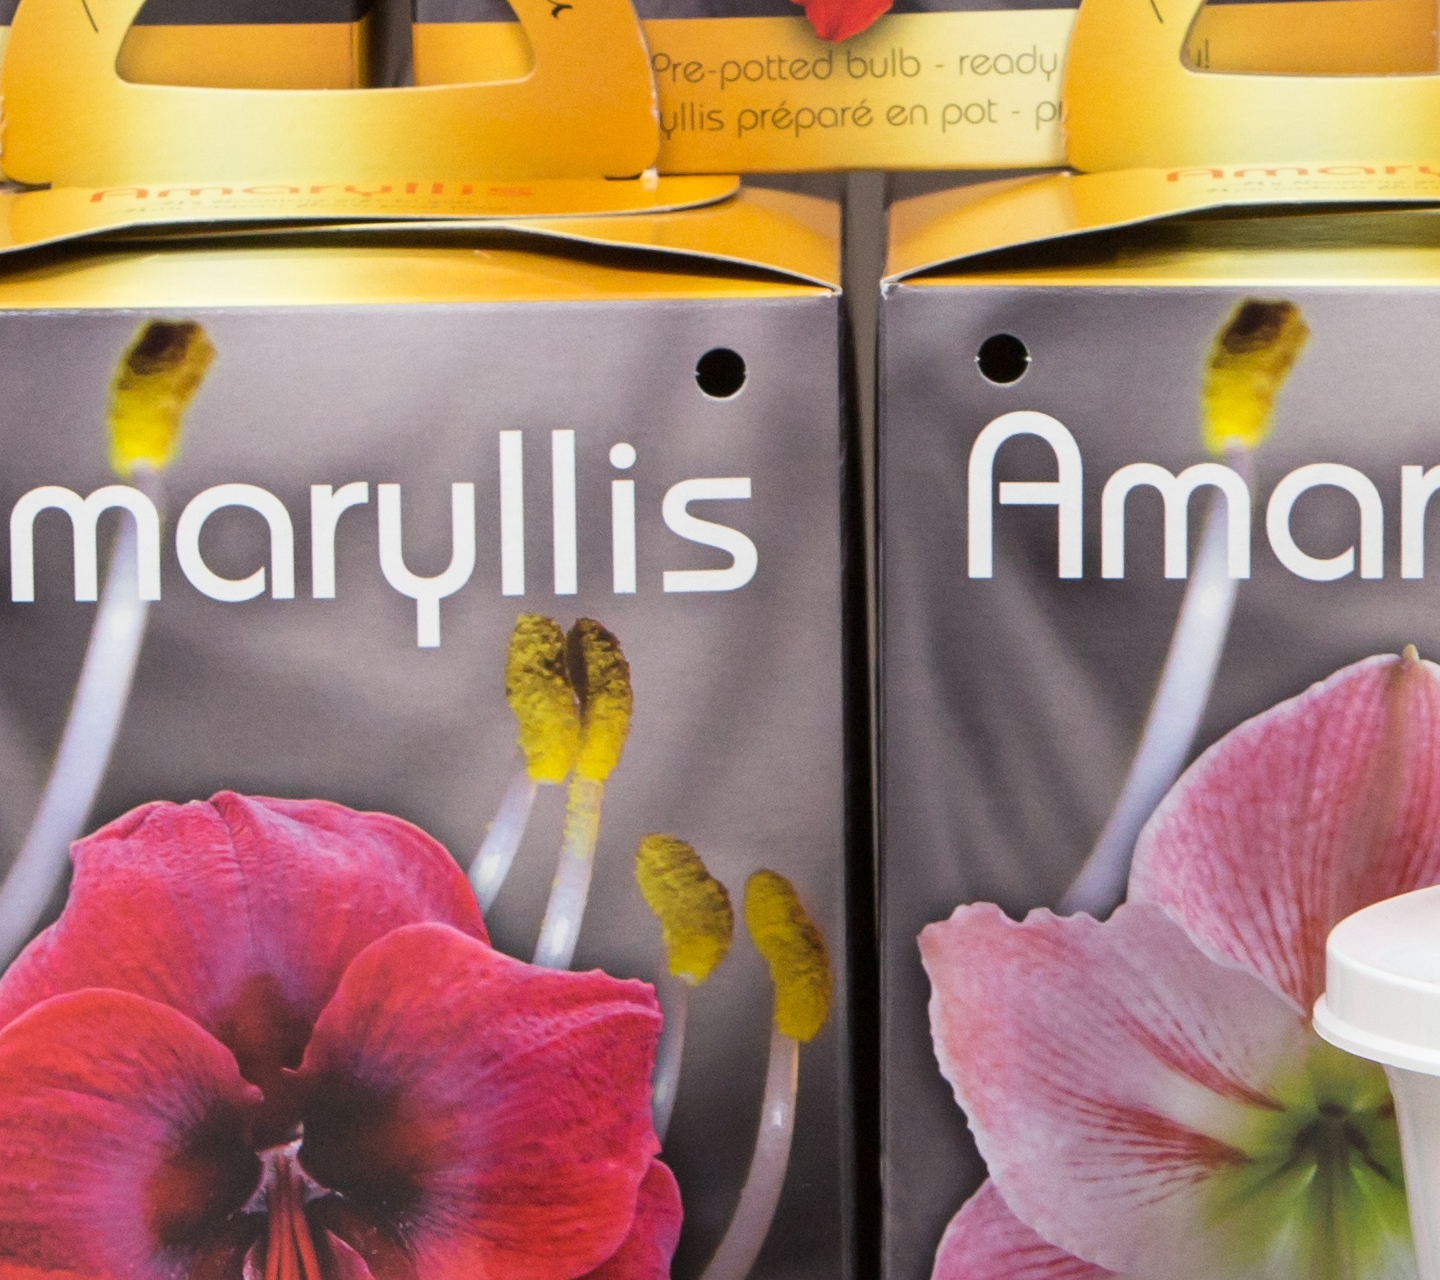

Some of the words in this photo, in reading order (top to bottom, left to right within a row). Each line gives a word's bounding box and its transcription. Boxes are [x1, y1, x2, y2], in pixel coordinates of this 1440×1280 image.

[847, 48, 921, 79] bulb
[960, 45, 1057, 81] ready
[660, 102, 724, 140] yllis
[738, 102, 872, 138] préparé
[886, 104, 927, 126] en
[942, 99, 998, 133] pot
[89, 182, 536, 204] Amaryllis
